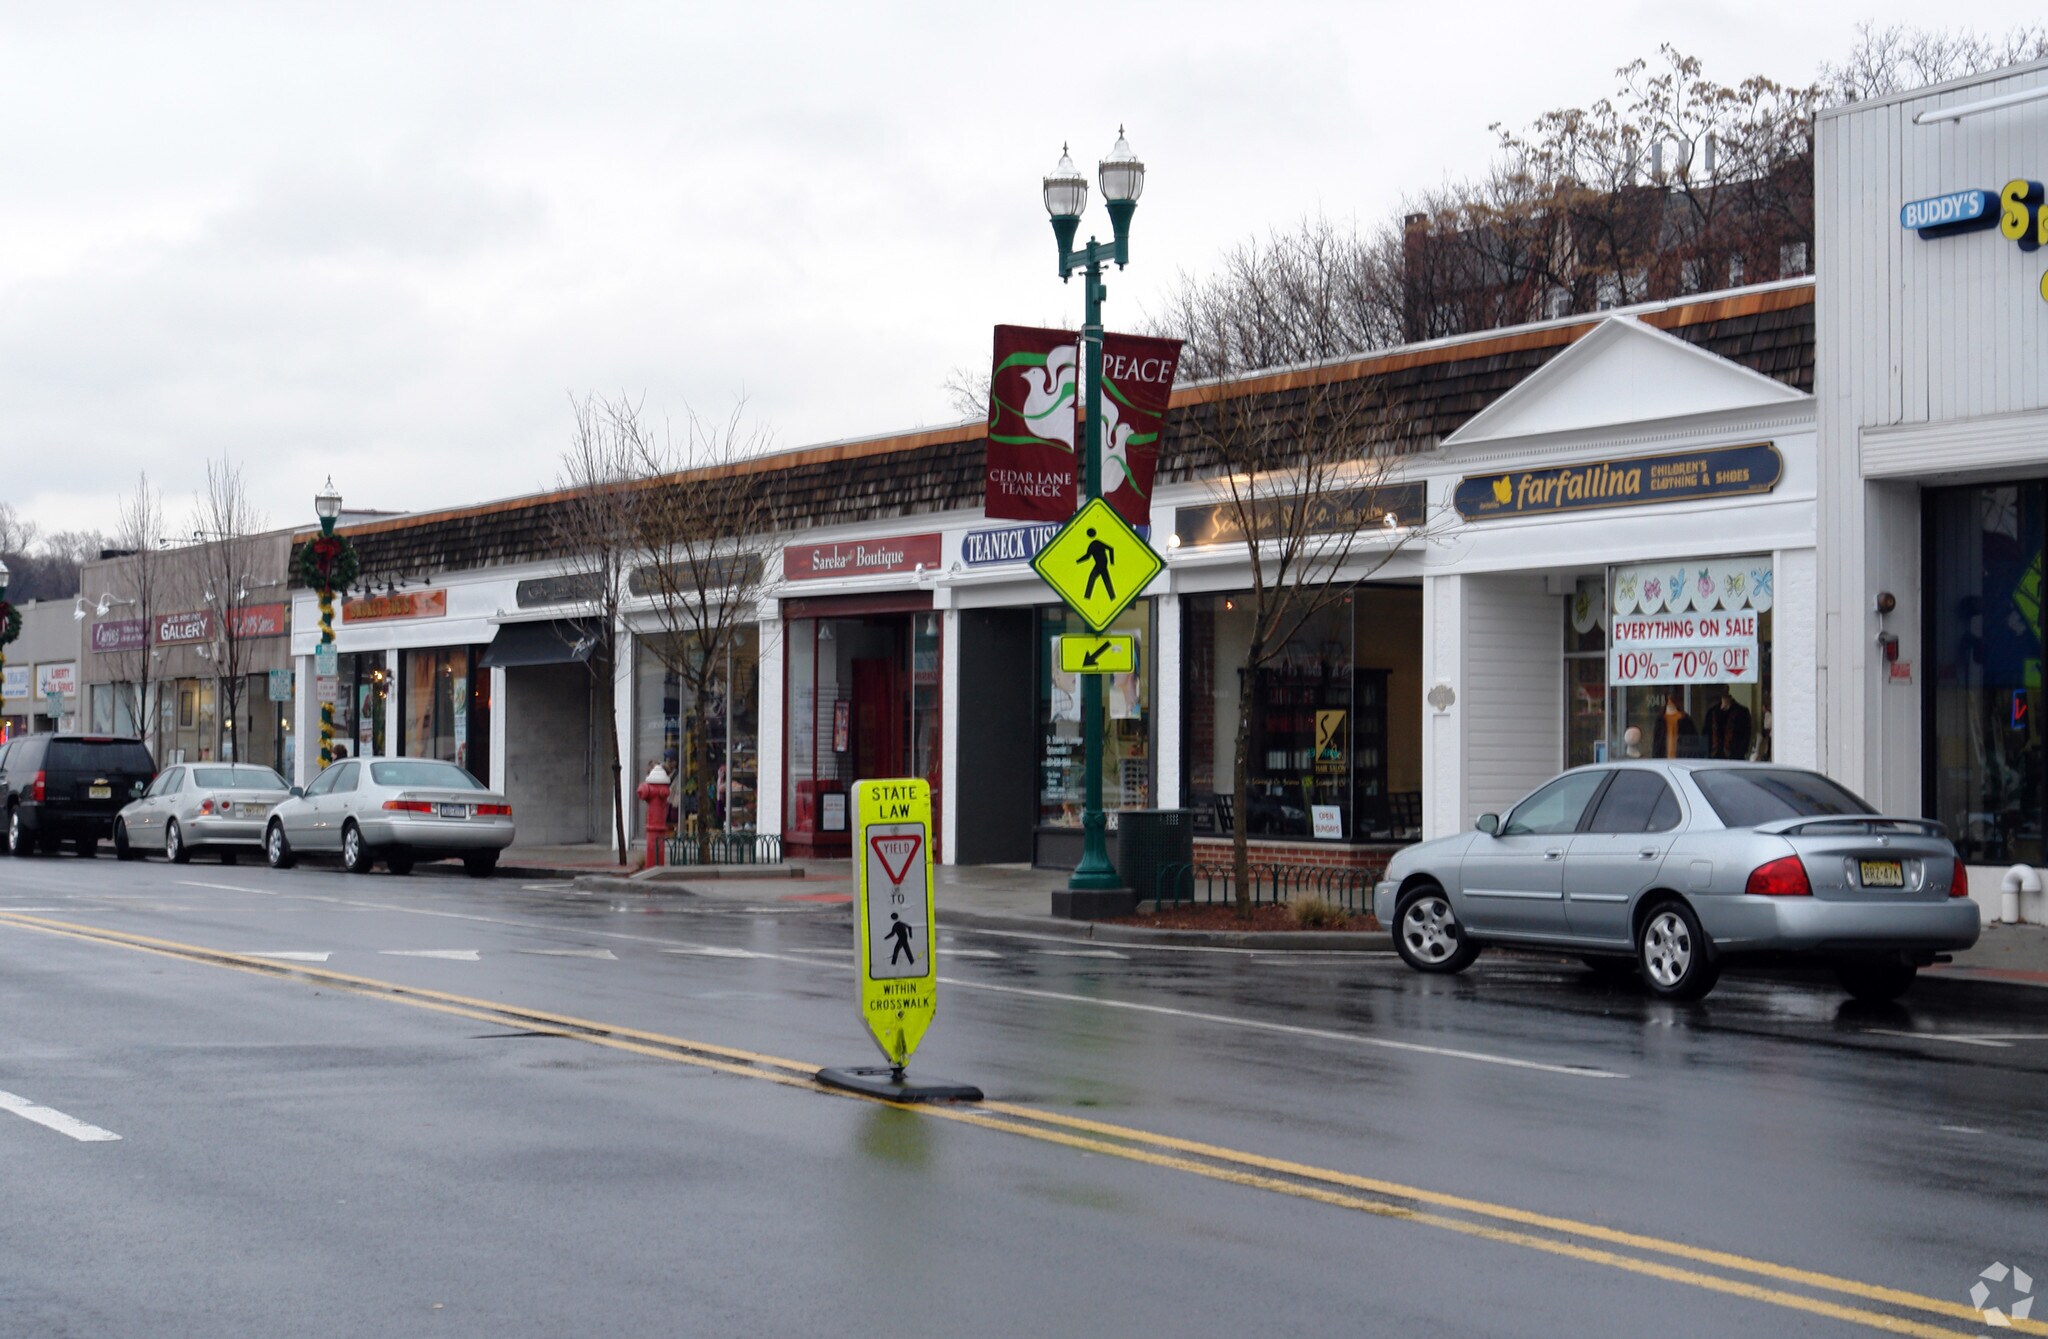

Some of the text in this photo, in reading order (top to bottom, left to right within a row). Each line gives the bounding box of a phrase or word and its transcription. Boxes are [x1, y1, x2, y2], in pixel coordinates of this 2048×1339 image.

[1906, 191, 1980, 227] BUDDY'S
[1102, 353, 1173, 384] PEACE
[990, 468, 1072, 485] CEDAR LANE
[1650, 460, 1708, 478] CHILDREN'S
[1517, 464, 1641, 510] farfallina
[1650, 468, 1750, 491] CLOTHING & SHOES
[1001, 482, 1062, 497] TEANECK
[967, 530, 1026, 562] TEANECK
[812, 545, 905, 571] Sareka Boutique
[161, 618, 208, 641] GALLERY
[1615, 618, 1754, 640] EVERYTHING ON SALE
[1723, 648, 1750, 667] OFF
[872, 786, 917, 801] STATE
[880, 804, 910, 819] LAW
[1318, 812, 1334, 820] OPEN
[884, 843, 910, 854] YIELD
[891, 894, 905, 904] TO
[883, 982, 917, 995] WITHIN
[870, 996, 930, 1011] CROSSWALK
